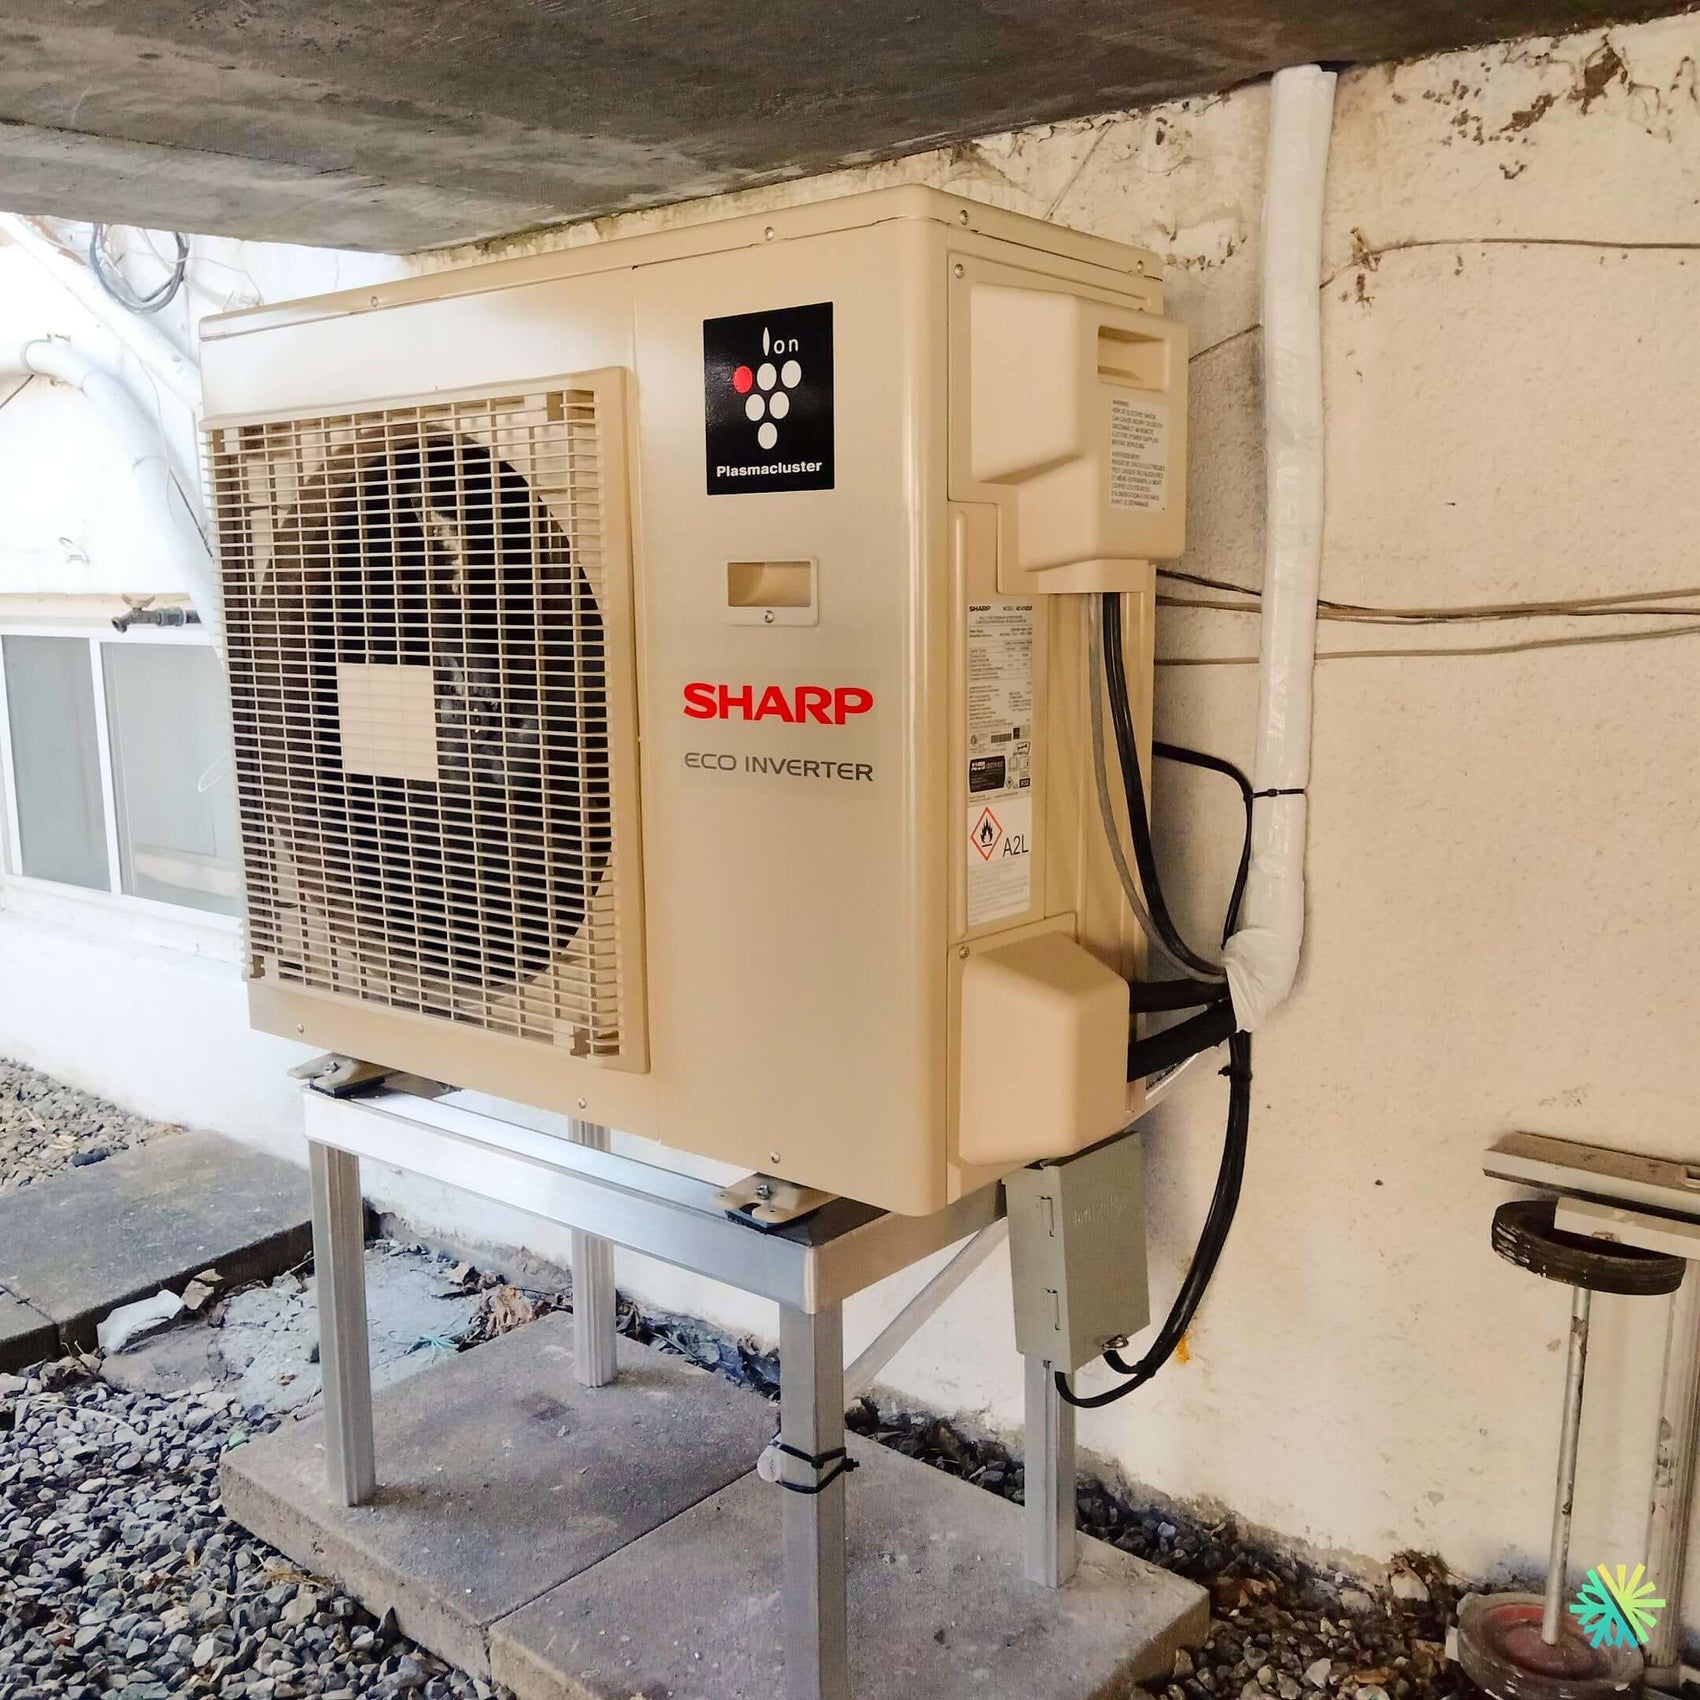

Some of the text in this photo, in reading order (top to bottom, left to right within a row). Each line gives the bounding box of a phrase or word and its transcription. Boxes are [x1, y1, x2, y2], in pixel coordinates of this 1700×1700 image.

[762, 326, 799, 357] Ion
[716, 461, 823, 478] Plasmacluster
[683, 682, 874, 725] SHARP
[684, 752, 874, 782] ECO INVERTER
[1002, 834, 1029, 858] A2L
